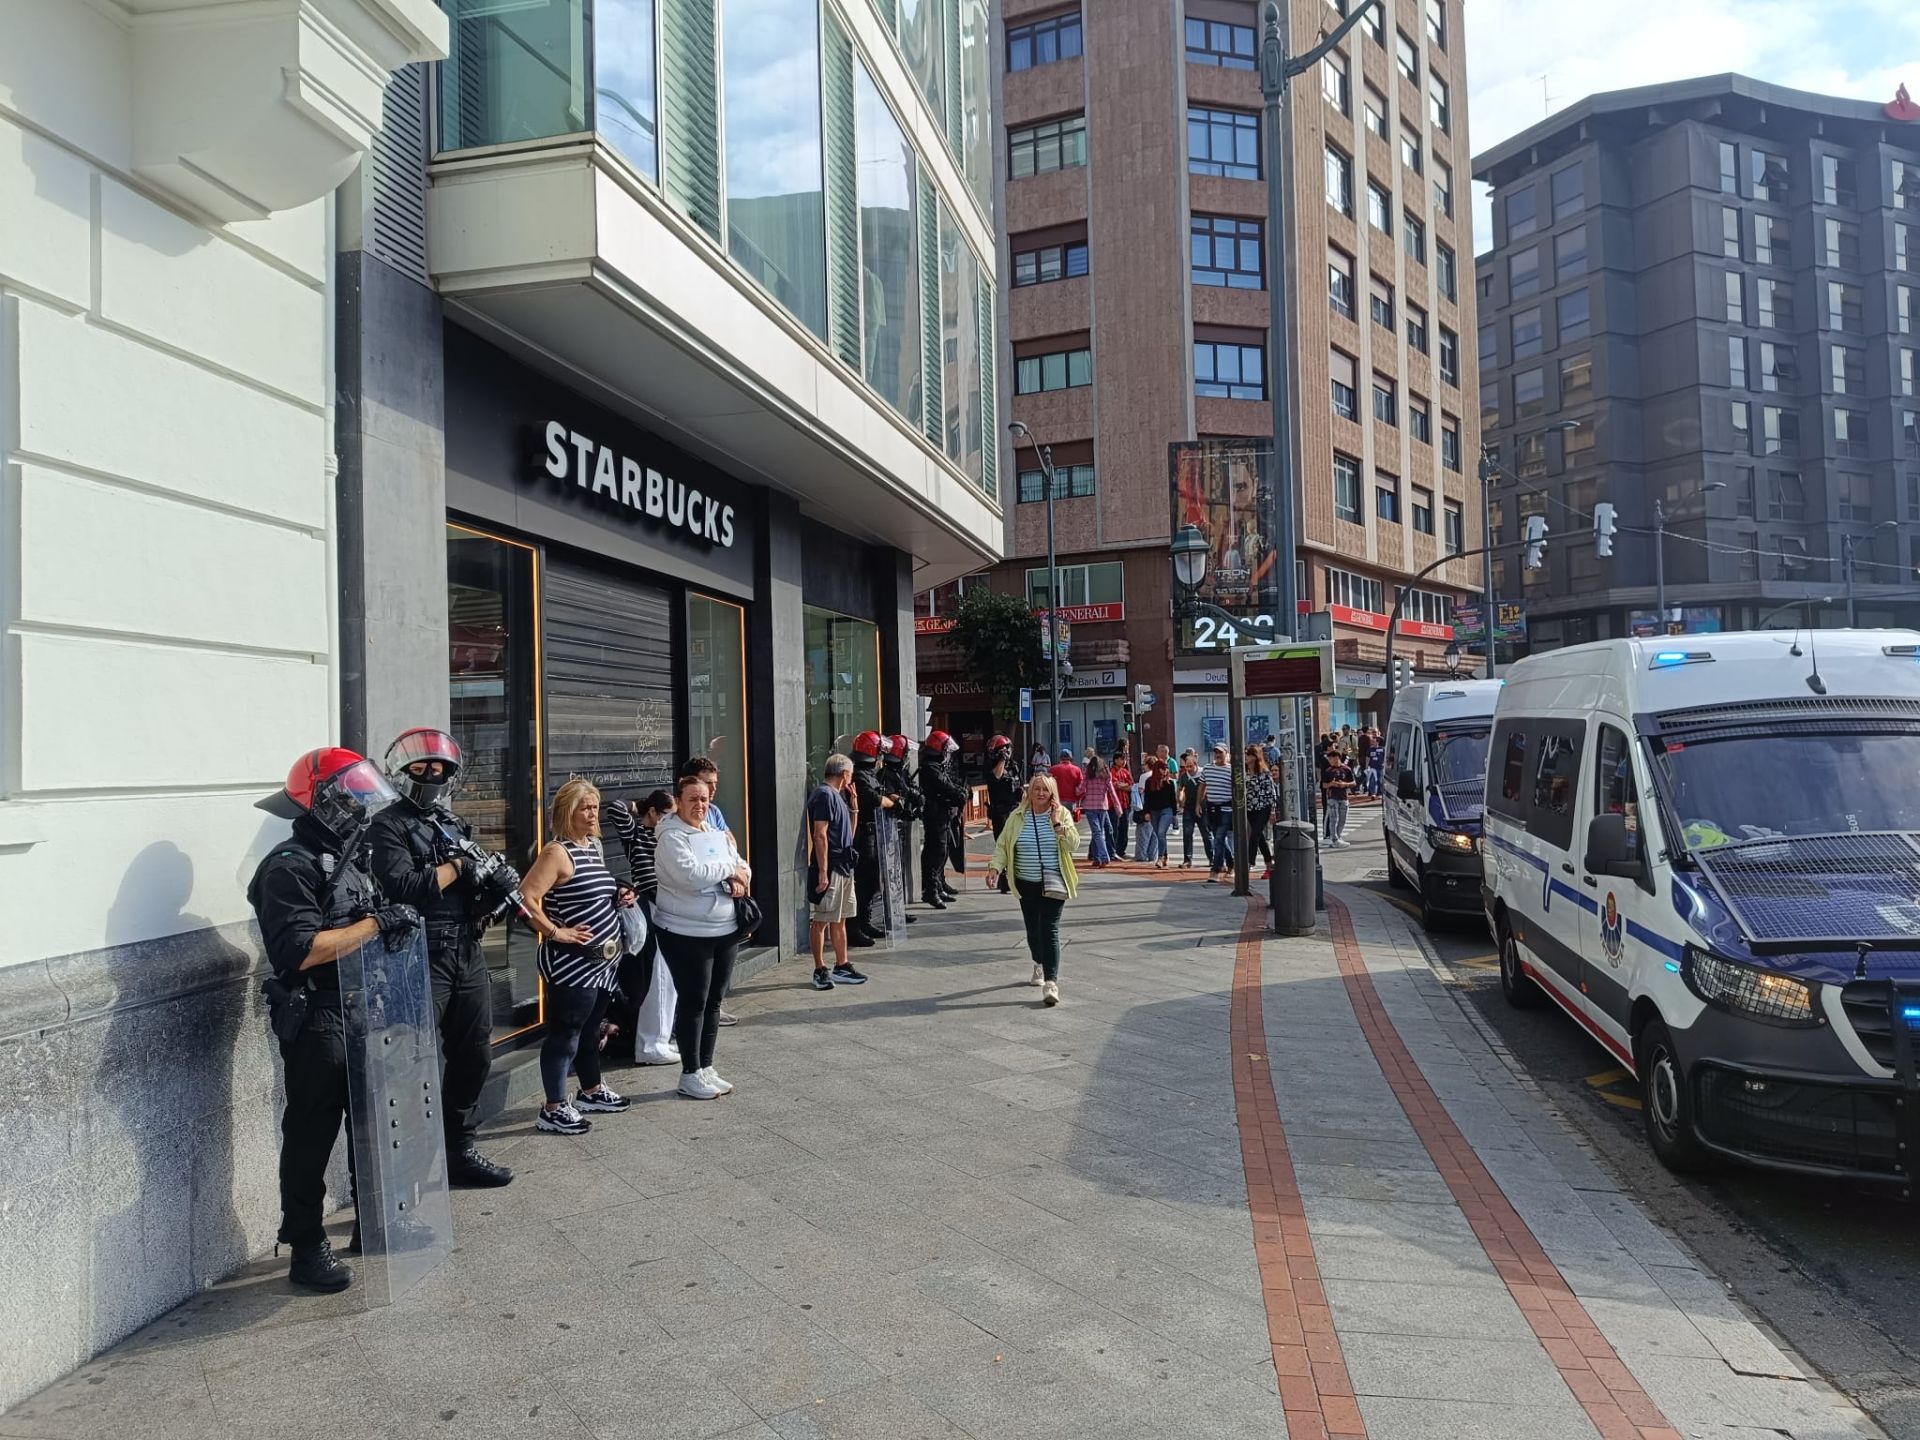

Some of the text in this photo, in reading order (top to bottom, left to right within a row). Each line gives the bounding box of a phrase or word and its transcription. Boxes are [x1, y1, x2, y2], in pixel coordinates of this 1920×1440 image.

[545, 421, 735, 548] STARBUCKS
[1078, 677, 1100, 686] Bank
[1205, 672, 1229, 682] Deuts
